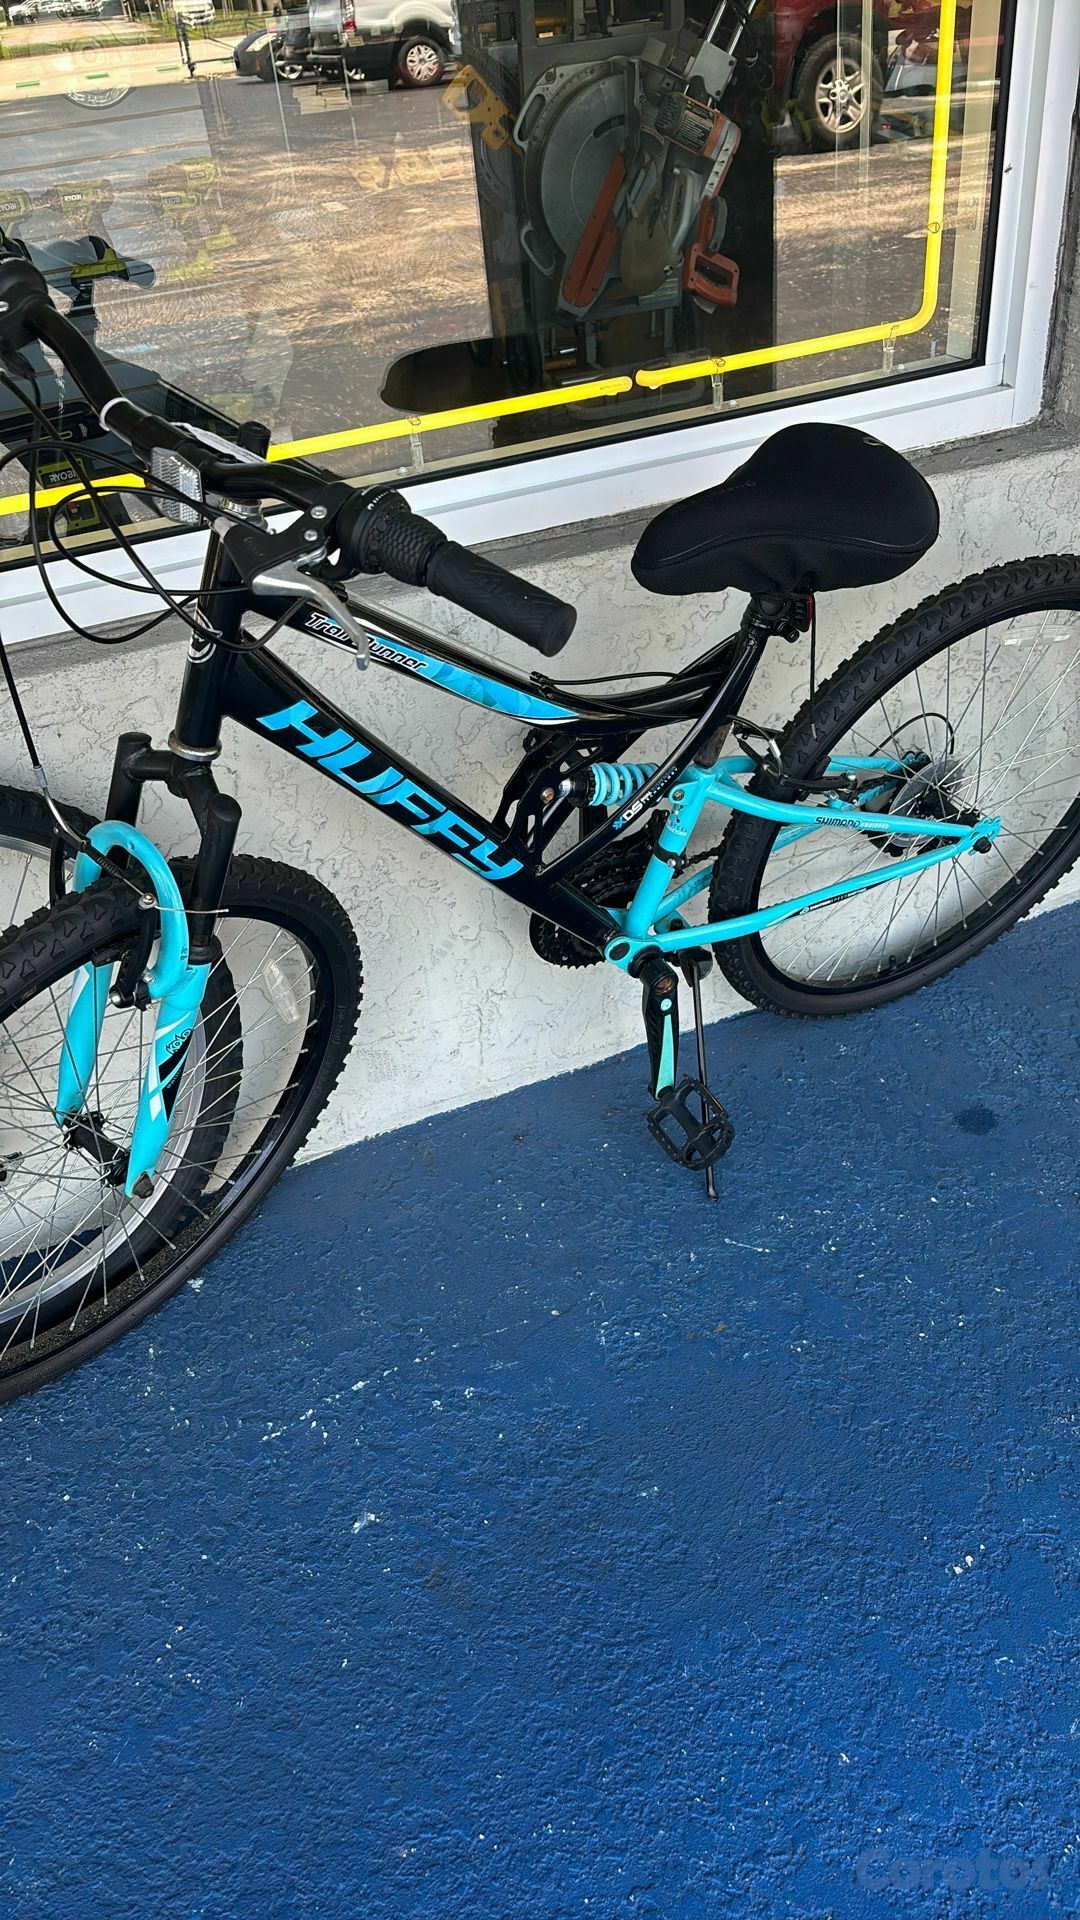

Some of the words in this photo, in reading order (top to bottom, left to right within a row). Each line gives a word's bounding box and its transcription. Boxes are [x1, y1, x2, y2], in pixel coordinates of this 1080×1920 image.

[48, 468, 78, 483] RYOBI
[256, 700, 524, 880] HUFFY
[814, 816, 860, 829] SHIMANO
